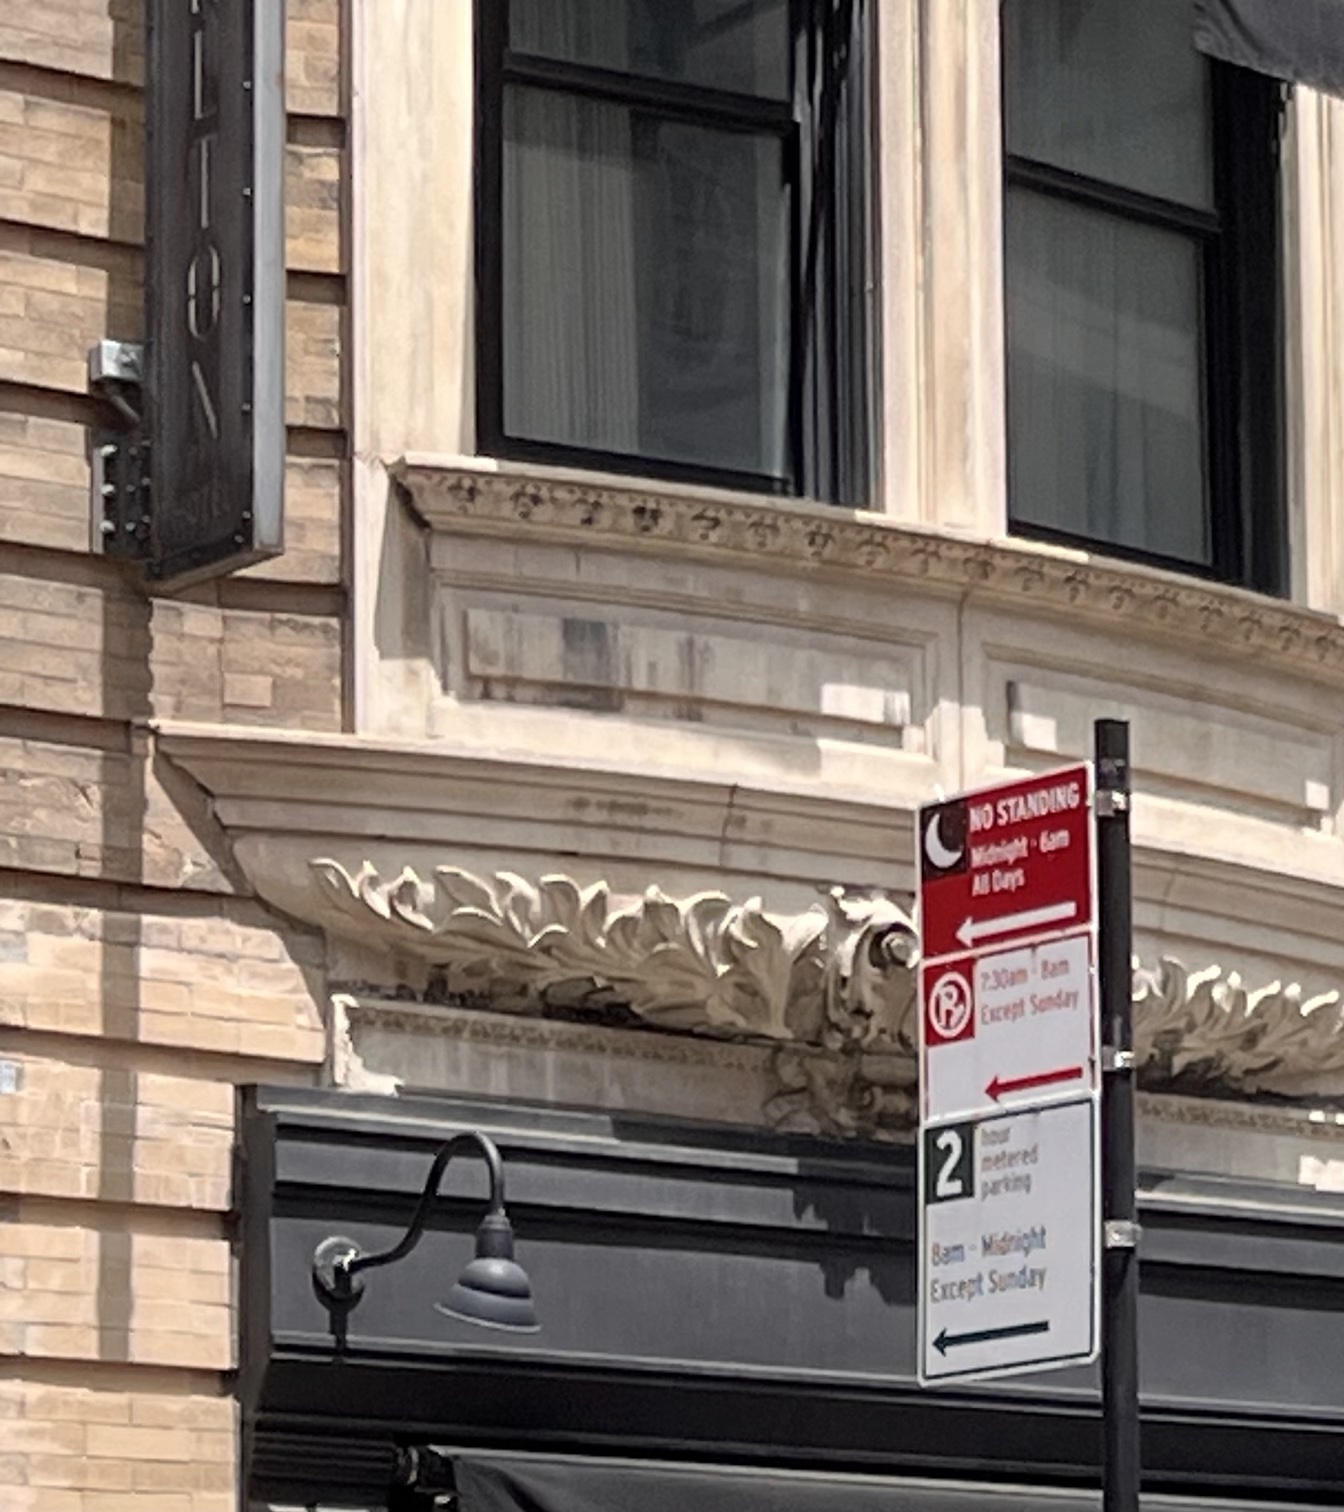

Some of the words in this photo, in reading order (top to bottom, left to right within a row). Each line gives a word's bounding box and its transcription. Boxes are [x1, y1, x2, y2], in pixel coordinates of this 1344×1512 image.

[969, 803, 993, 832] NO
[997, 782, 1080, 827] STANDING
[971, 836, 1028, 867] Midnight
[1039, 829, 1070, 853] 6am
[972, 872, 990, 897] All
[991, 868, 1026, 892] Days
[981, 999, 1025, 1025] Except
[1030, 989, 1079, 1016] Sunday
[936, 1130, 962, 1197] 2
[981, 1144, 1039, 1172] metered
[981, 1173, 1031, 1202] parking
[931, 1243, 965, 1267] 8am
[981, 1225, 1046, 1258] Midnight
[930, 1272, 984, 1303] Except
[988, 1264, 1047, 1294] Sunday
